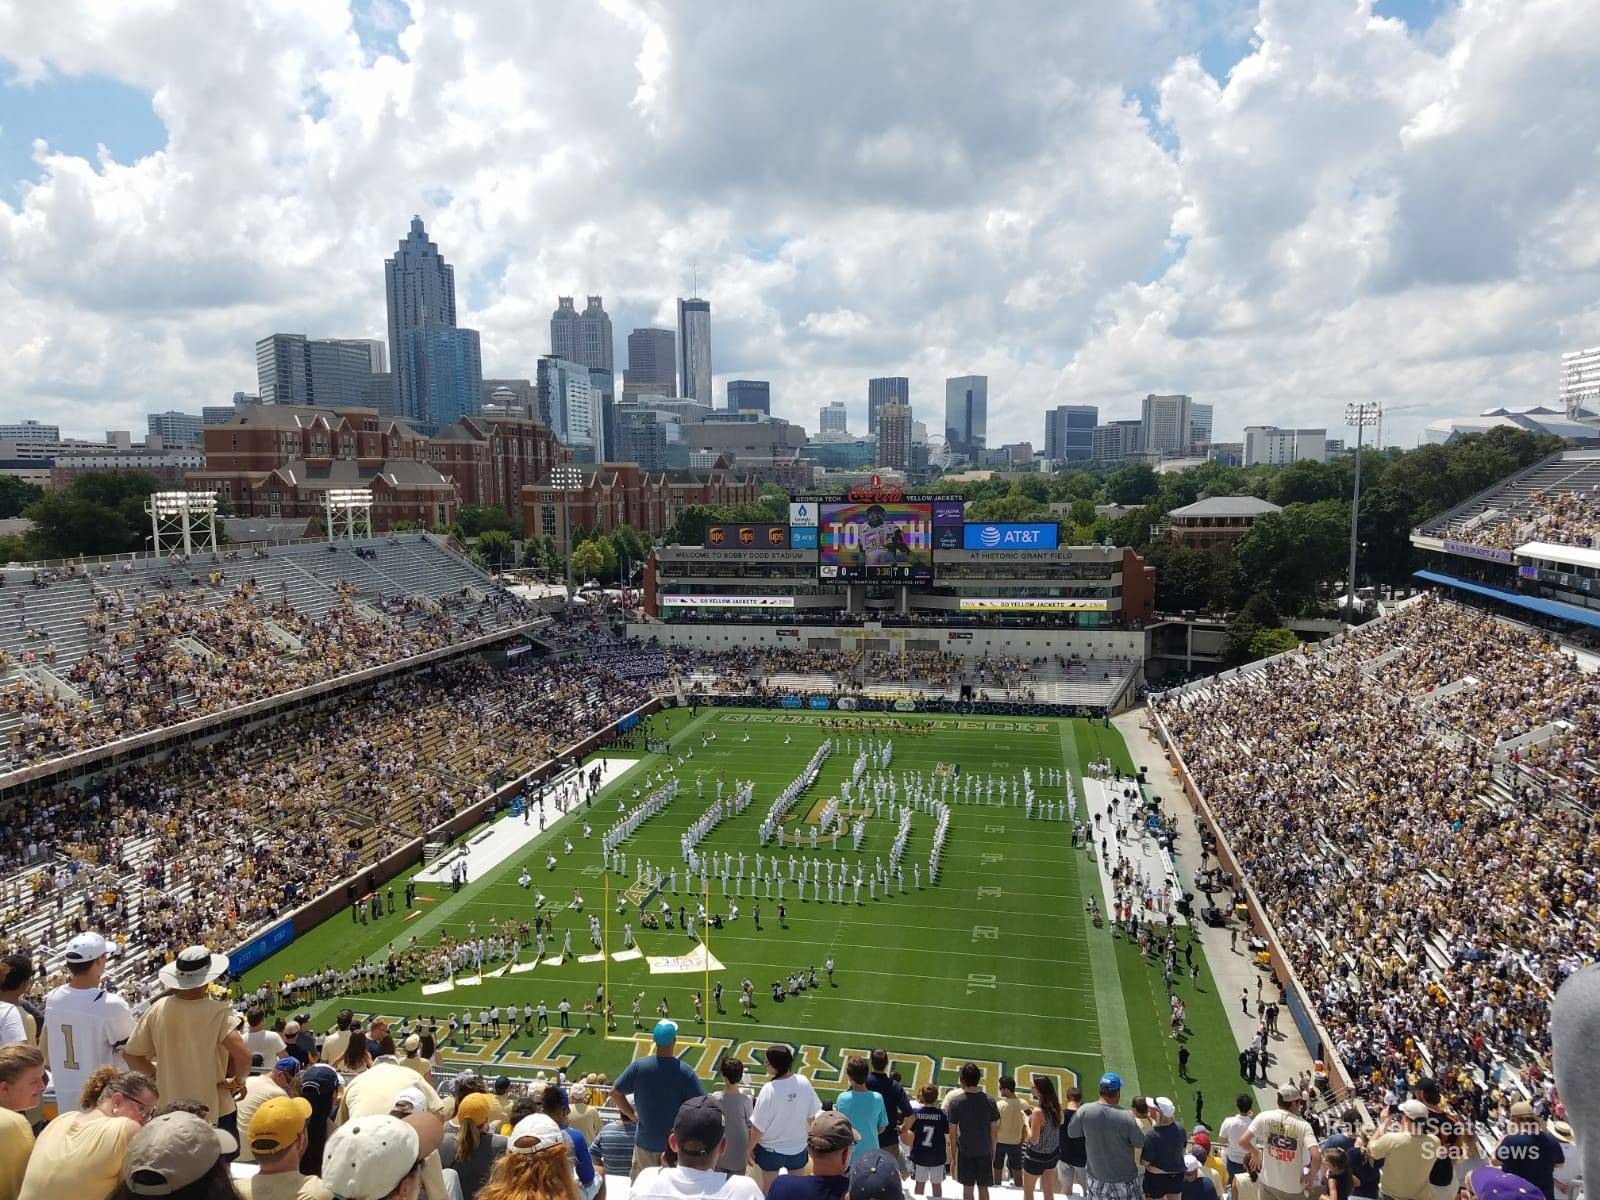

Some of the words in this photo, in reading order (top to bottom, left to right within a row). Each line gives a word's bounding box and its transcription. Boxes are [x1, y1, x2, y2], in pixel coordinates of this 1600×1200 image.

[711, 533, 724, 543] ups
[741, 533, 753, 543] ups
[771, 533, 784, 543] ups
[1004, 530, 1040, 543] AT&T
[973, 925, 999, 940] 20
[967, 973, 996, 989] 10
[60, 1024, 80, 1071] 1
[921, 1126, 935, 1147] 7
